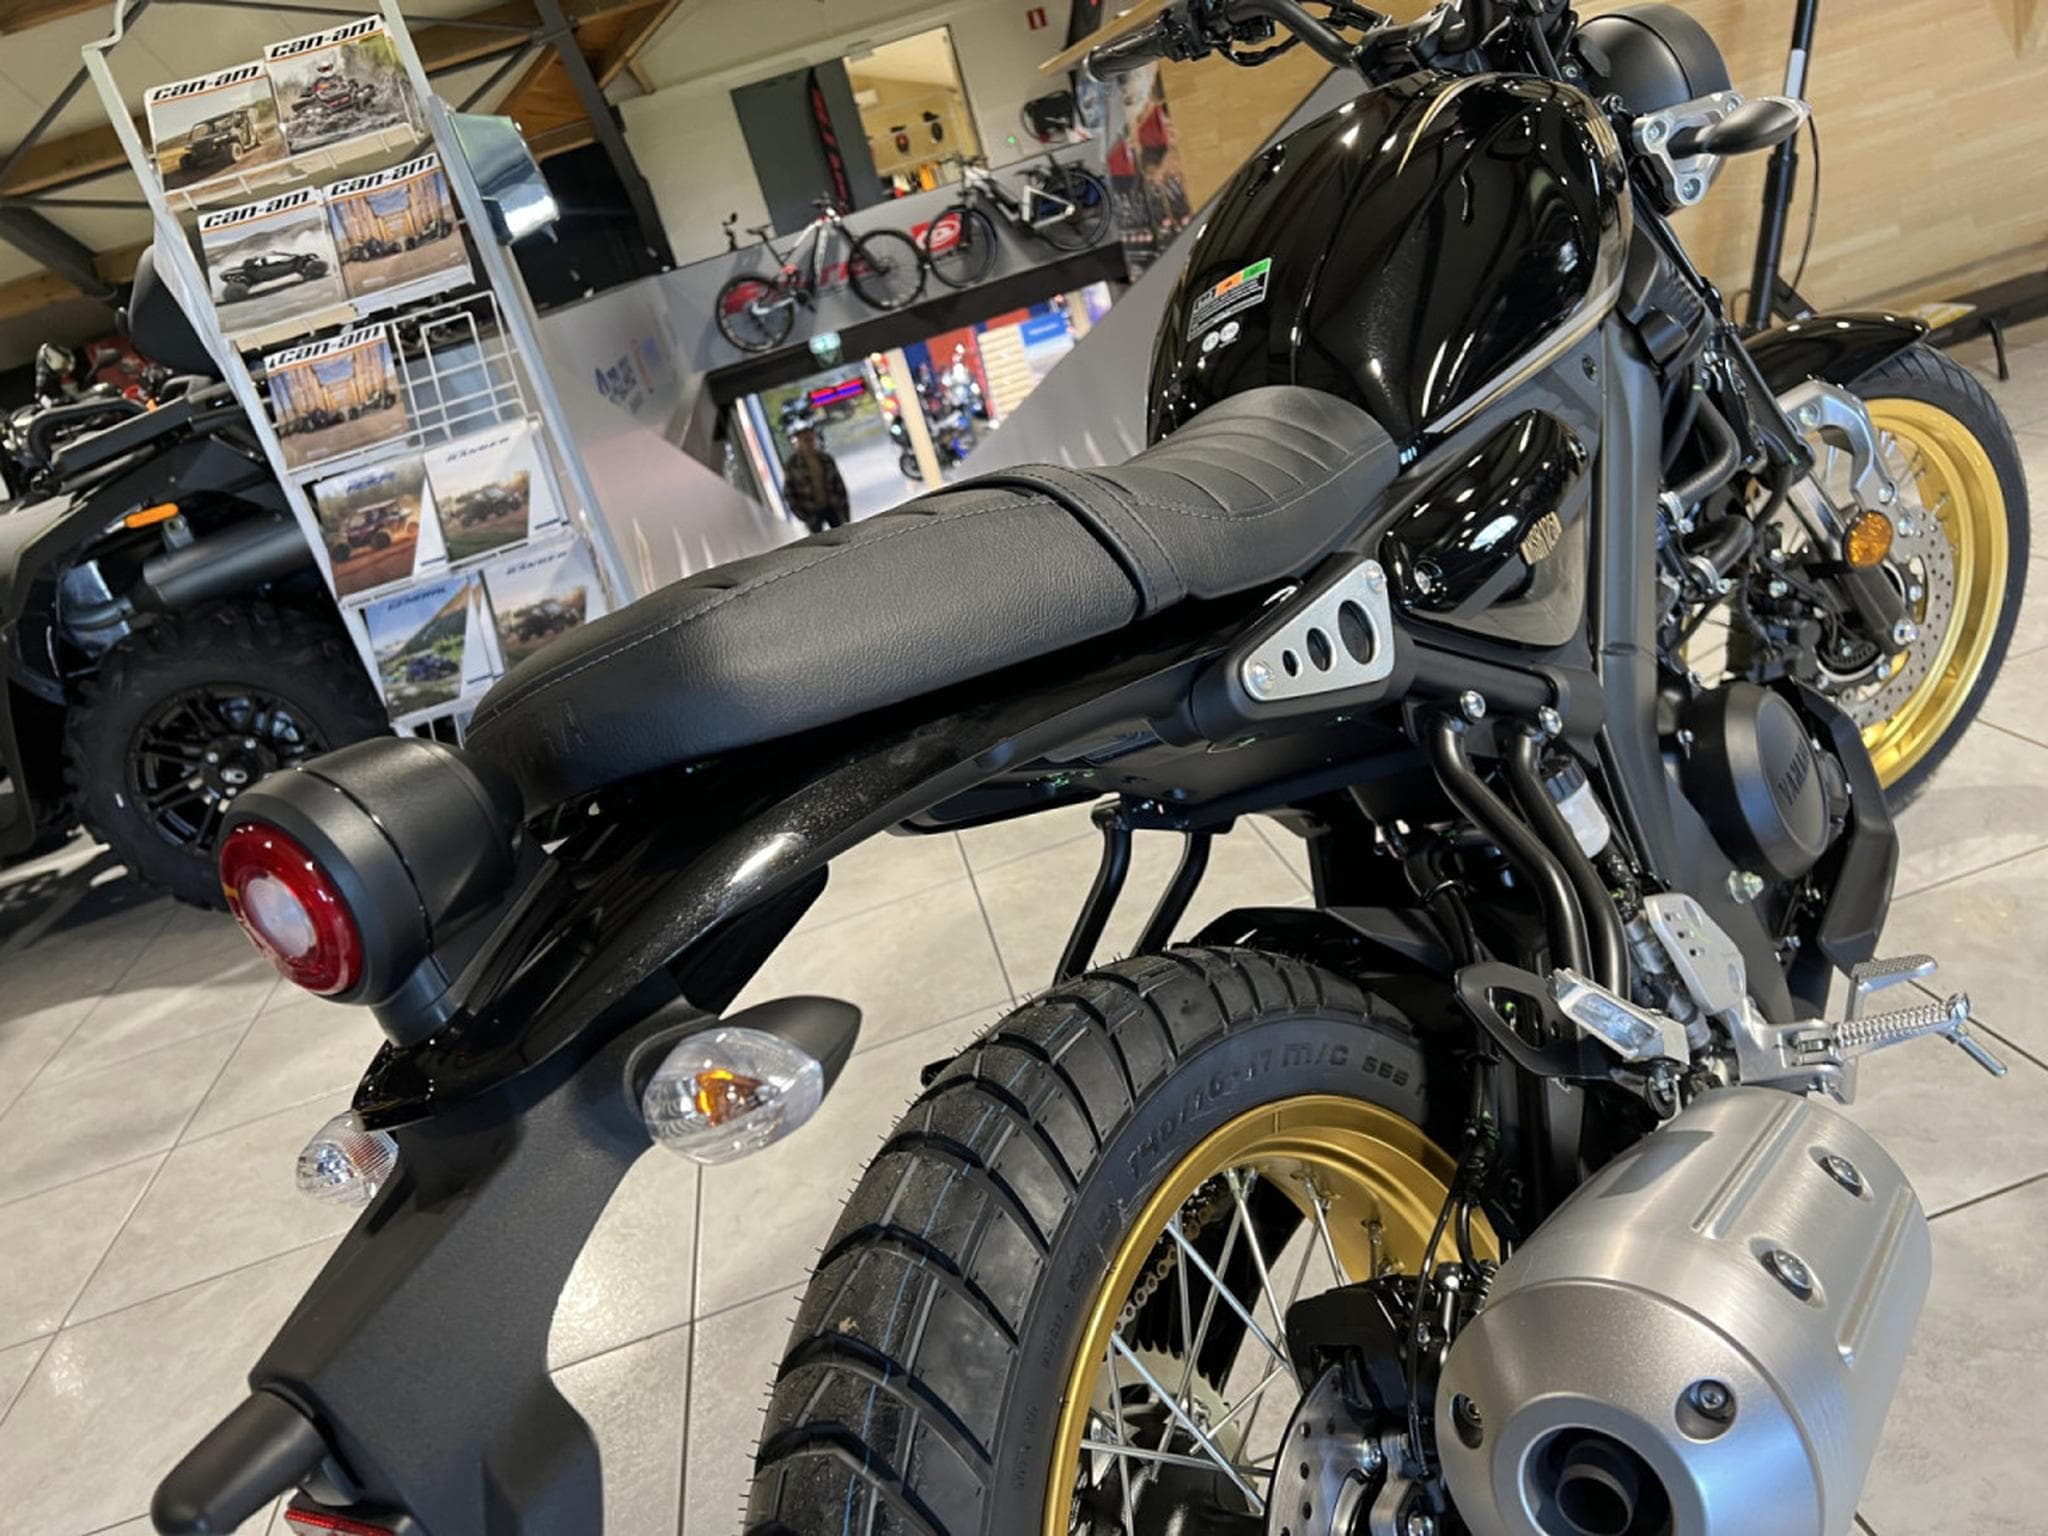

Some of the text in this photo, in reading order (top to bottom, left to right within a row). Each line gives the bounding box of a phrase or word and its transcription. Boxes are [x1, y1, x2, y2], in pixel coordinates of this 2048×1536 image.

[271, 20, 376, 58] can-am
[153, 66, 258, 101] can-am
[331, 155, 434, 195] can-am
[204, 191, 309, 228] can-am
[278, 326, 380, 364] can-am
